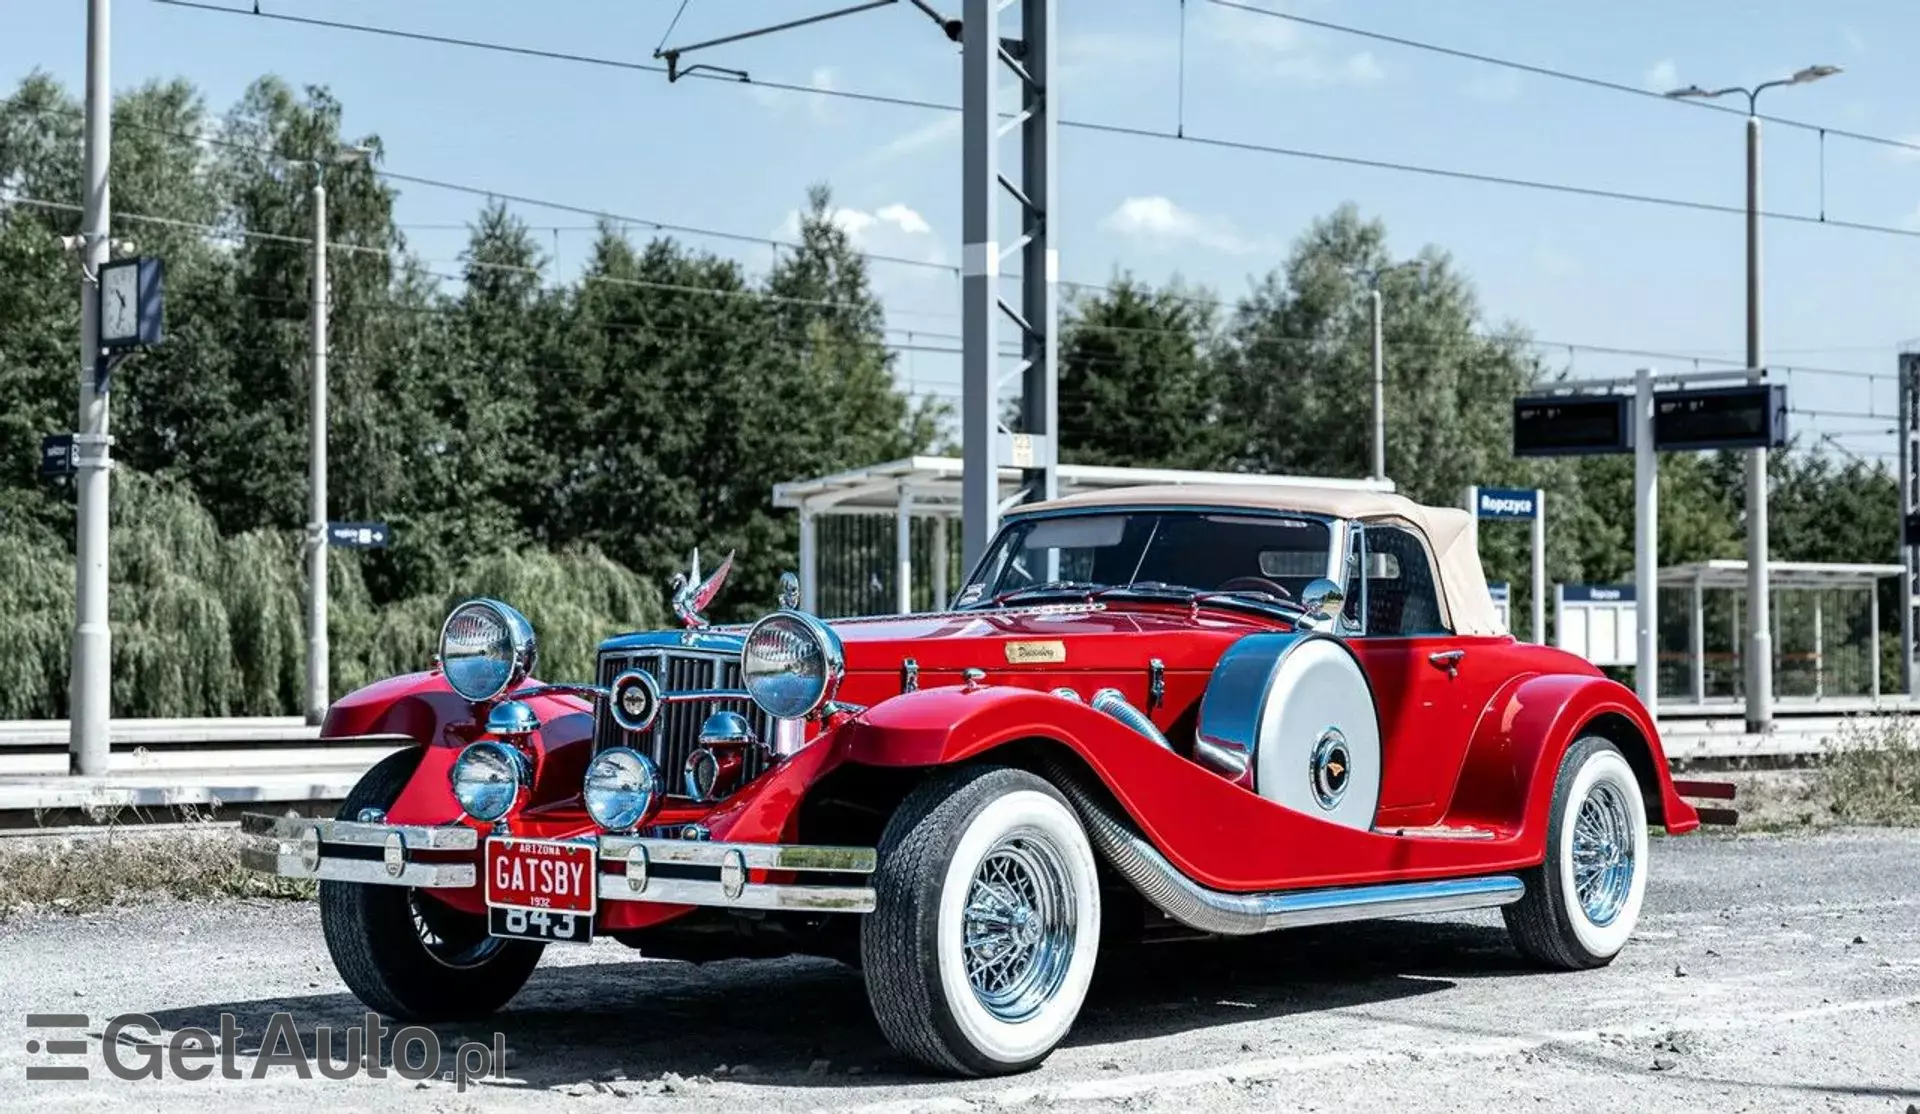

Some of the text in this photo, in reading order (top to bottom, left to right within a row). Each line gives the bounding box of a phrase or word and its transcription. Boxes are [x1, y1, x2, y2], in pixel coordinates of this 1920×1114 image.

[1481, 495, 1532, 515] Ropczyce
[519, 843, 561, 856] ARIZONA
[496, 855, 584, 897] GATSBY
[530, 896, 551, 908] 1932
[506, 908, 575, 938] 843
